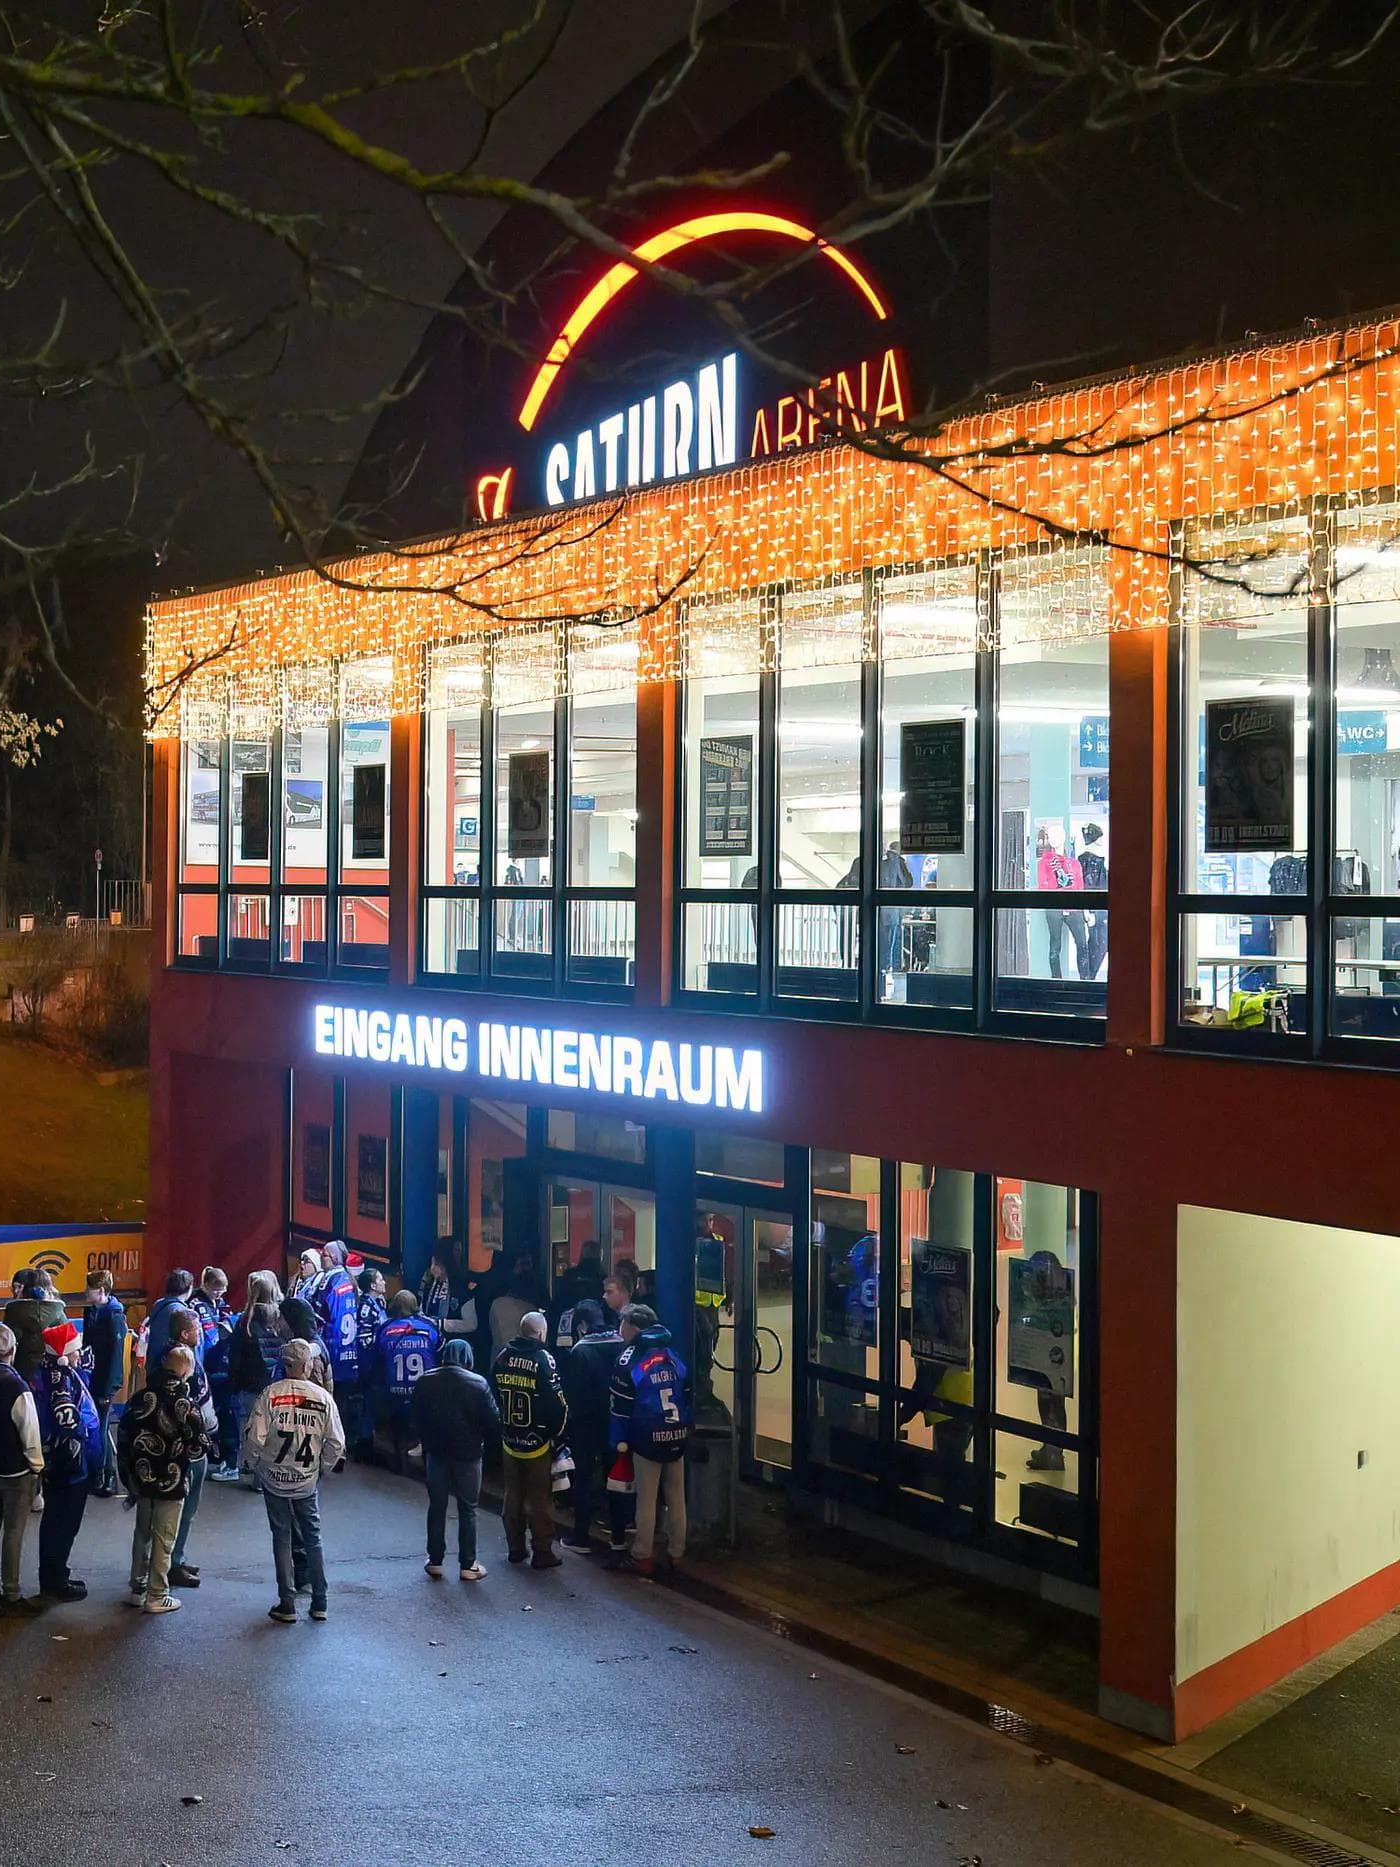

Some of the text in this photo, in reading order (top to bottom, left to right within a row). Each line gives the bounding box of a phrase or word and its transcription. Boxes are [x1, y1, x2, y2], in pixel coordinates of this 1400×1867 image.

[547, 348, 904, 507] SATURN ARENA
[1348, 726, 1374, 739] WC
[316, 1005, 762, 1113] EINGANG INNENRAUM
[393, 1353, 424, 1382] 19
[56, 1408, 74, 1425] 22
[499, 1389, 531, 1427] 19
[659, 1388, 680, 1424] 5
[274, 1431, 314, 1468] 74
